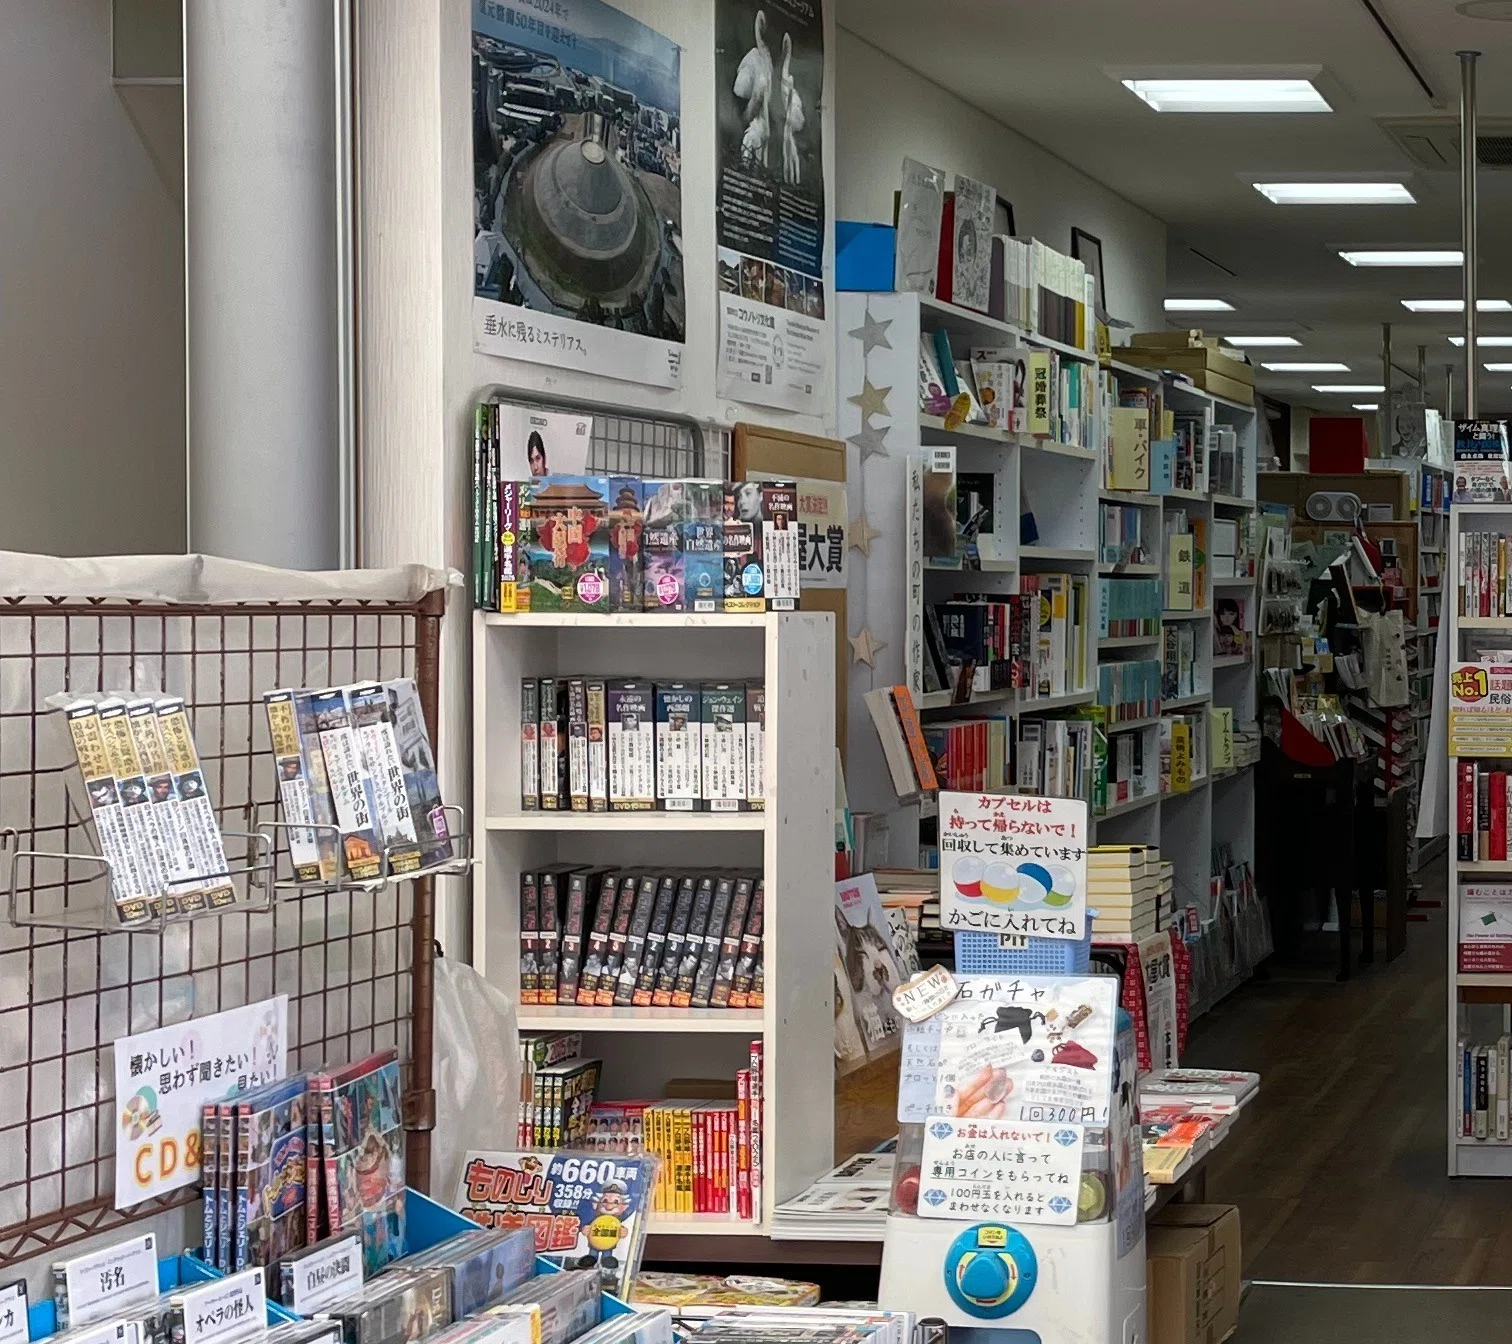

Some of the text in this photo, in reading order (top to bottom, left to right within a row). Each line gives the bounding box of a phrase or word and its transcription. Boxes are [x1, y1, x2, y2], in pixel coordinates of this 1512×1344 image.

[483, 314, 588, 356] 垂水に残るミステリアス。
[1033, 367, 1048, 420] 冠婚葬祭
[1177, 548, 1192, 596] 鉄道
[978, 795, 1053, 814] カプセルは
[948, 815, 1077, 839] 持って帰らないで!
[941, 839, 1087, 862] 回収して集めています
[948, 908, 1078, 935] かごに入れてね
[128, 1038, 197, 1079] 懐かしい!
[157, 1046, 259, 1095] 思わず聞きたい!
[956, 1127, 1051, 1143] お金は入れないで!
[952, 1148, 1052, 1164] お店の人に言って
[465, 1158, 554, 1205] ものしり
[550, 1158, 639, 1185] 約660車両
[931, 1165, 1070, 1184] 専用コインをもらってね
[554, 1184, 593, 1201] 358分
[949, 1187, 1046, 1202] 100円玉を入れると
[948, 1202, 1045, 1216] まわせなくなります
[99, 1265, 126, 1294] 汚名
[195, 1293, 255, 1334] オペラの怪人
